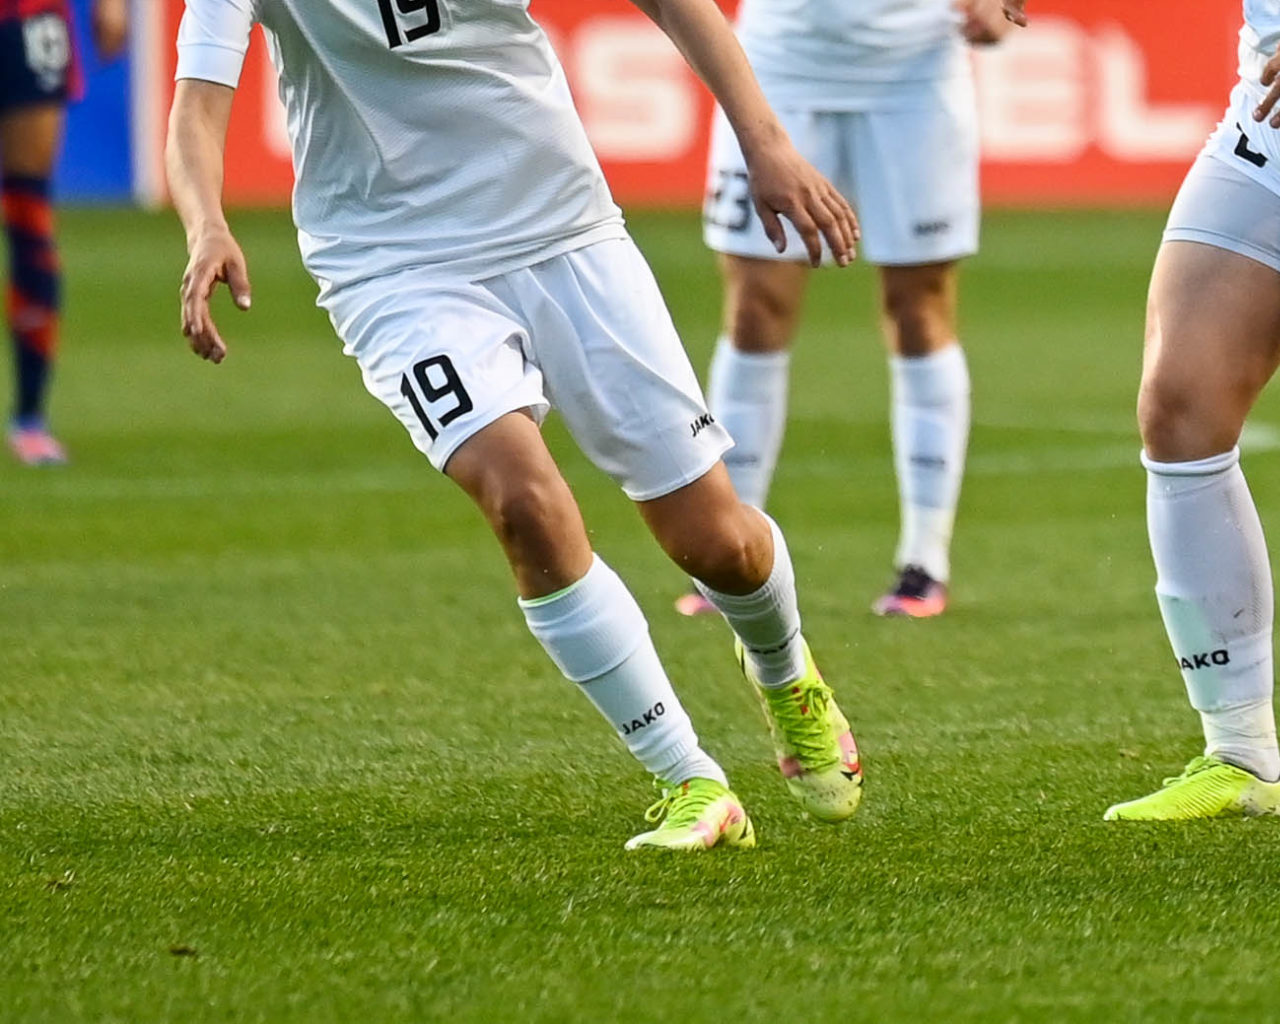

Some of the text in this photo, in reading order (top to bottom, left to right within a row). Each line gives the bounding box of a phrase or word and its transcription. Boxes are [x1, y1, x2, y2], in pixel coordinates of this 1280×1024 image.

[400, 354, 473, 442] 19
[1181, 649, 1230, 670] AKO
[621, 702, 665, 735] JAKO
